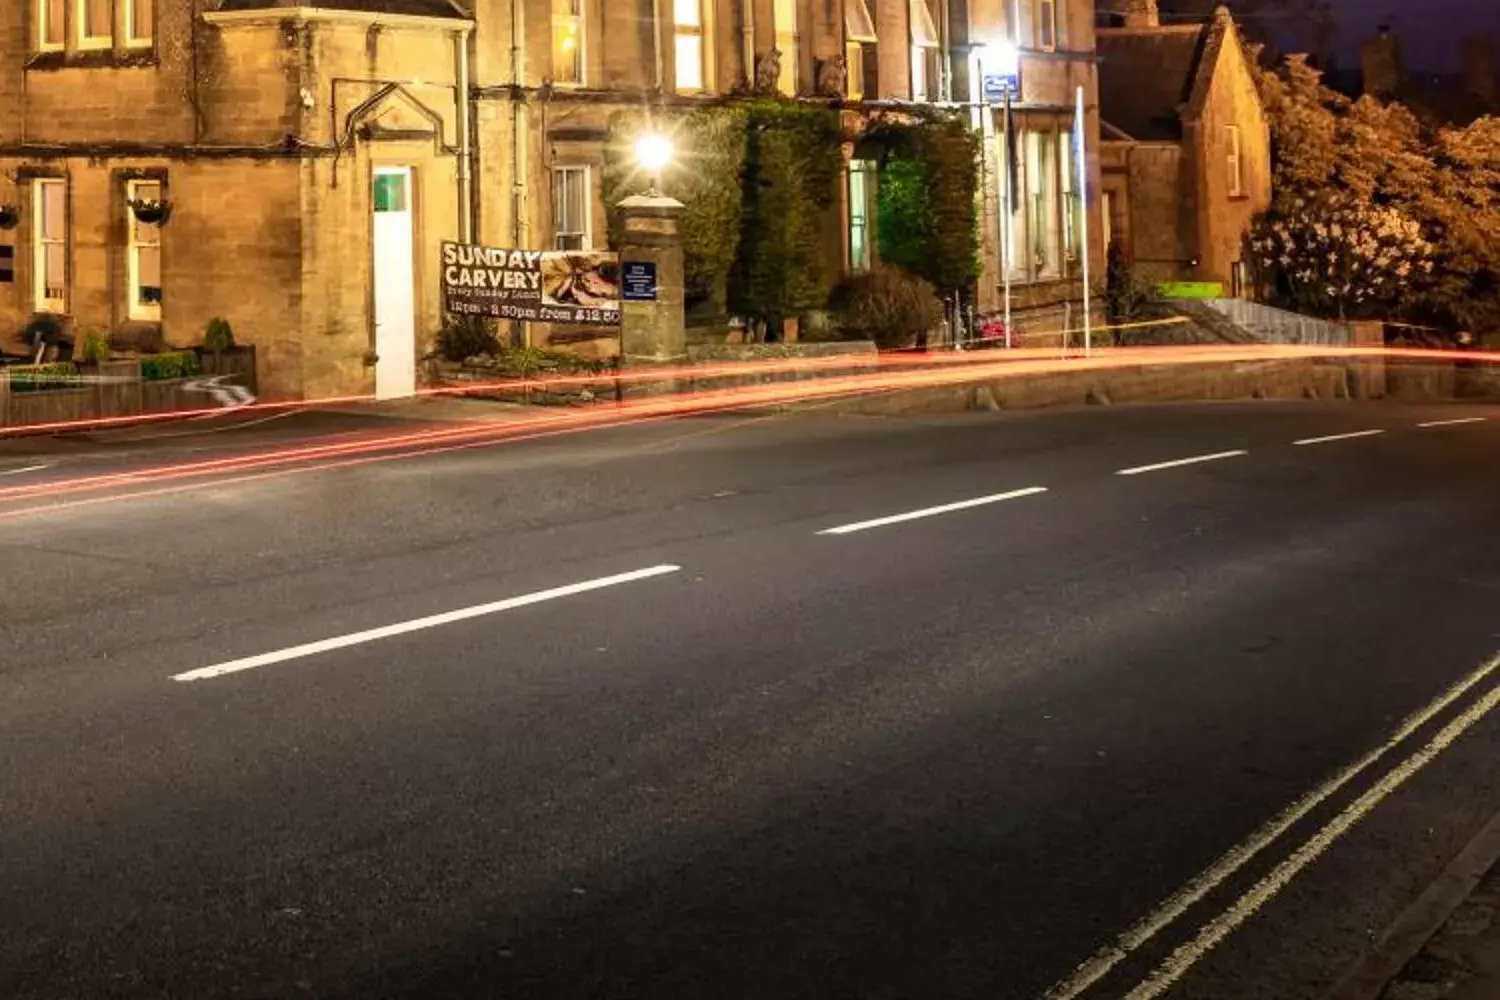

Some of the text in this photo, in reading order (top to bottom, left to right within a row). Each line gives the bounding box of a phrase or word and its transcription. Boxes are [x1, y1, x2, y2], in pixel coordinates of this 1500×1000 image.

[443, 243, 540, 268] SUNDAY
[445, 266, 540, 289] CARVERY
[539, 307, 571, 320] from
